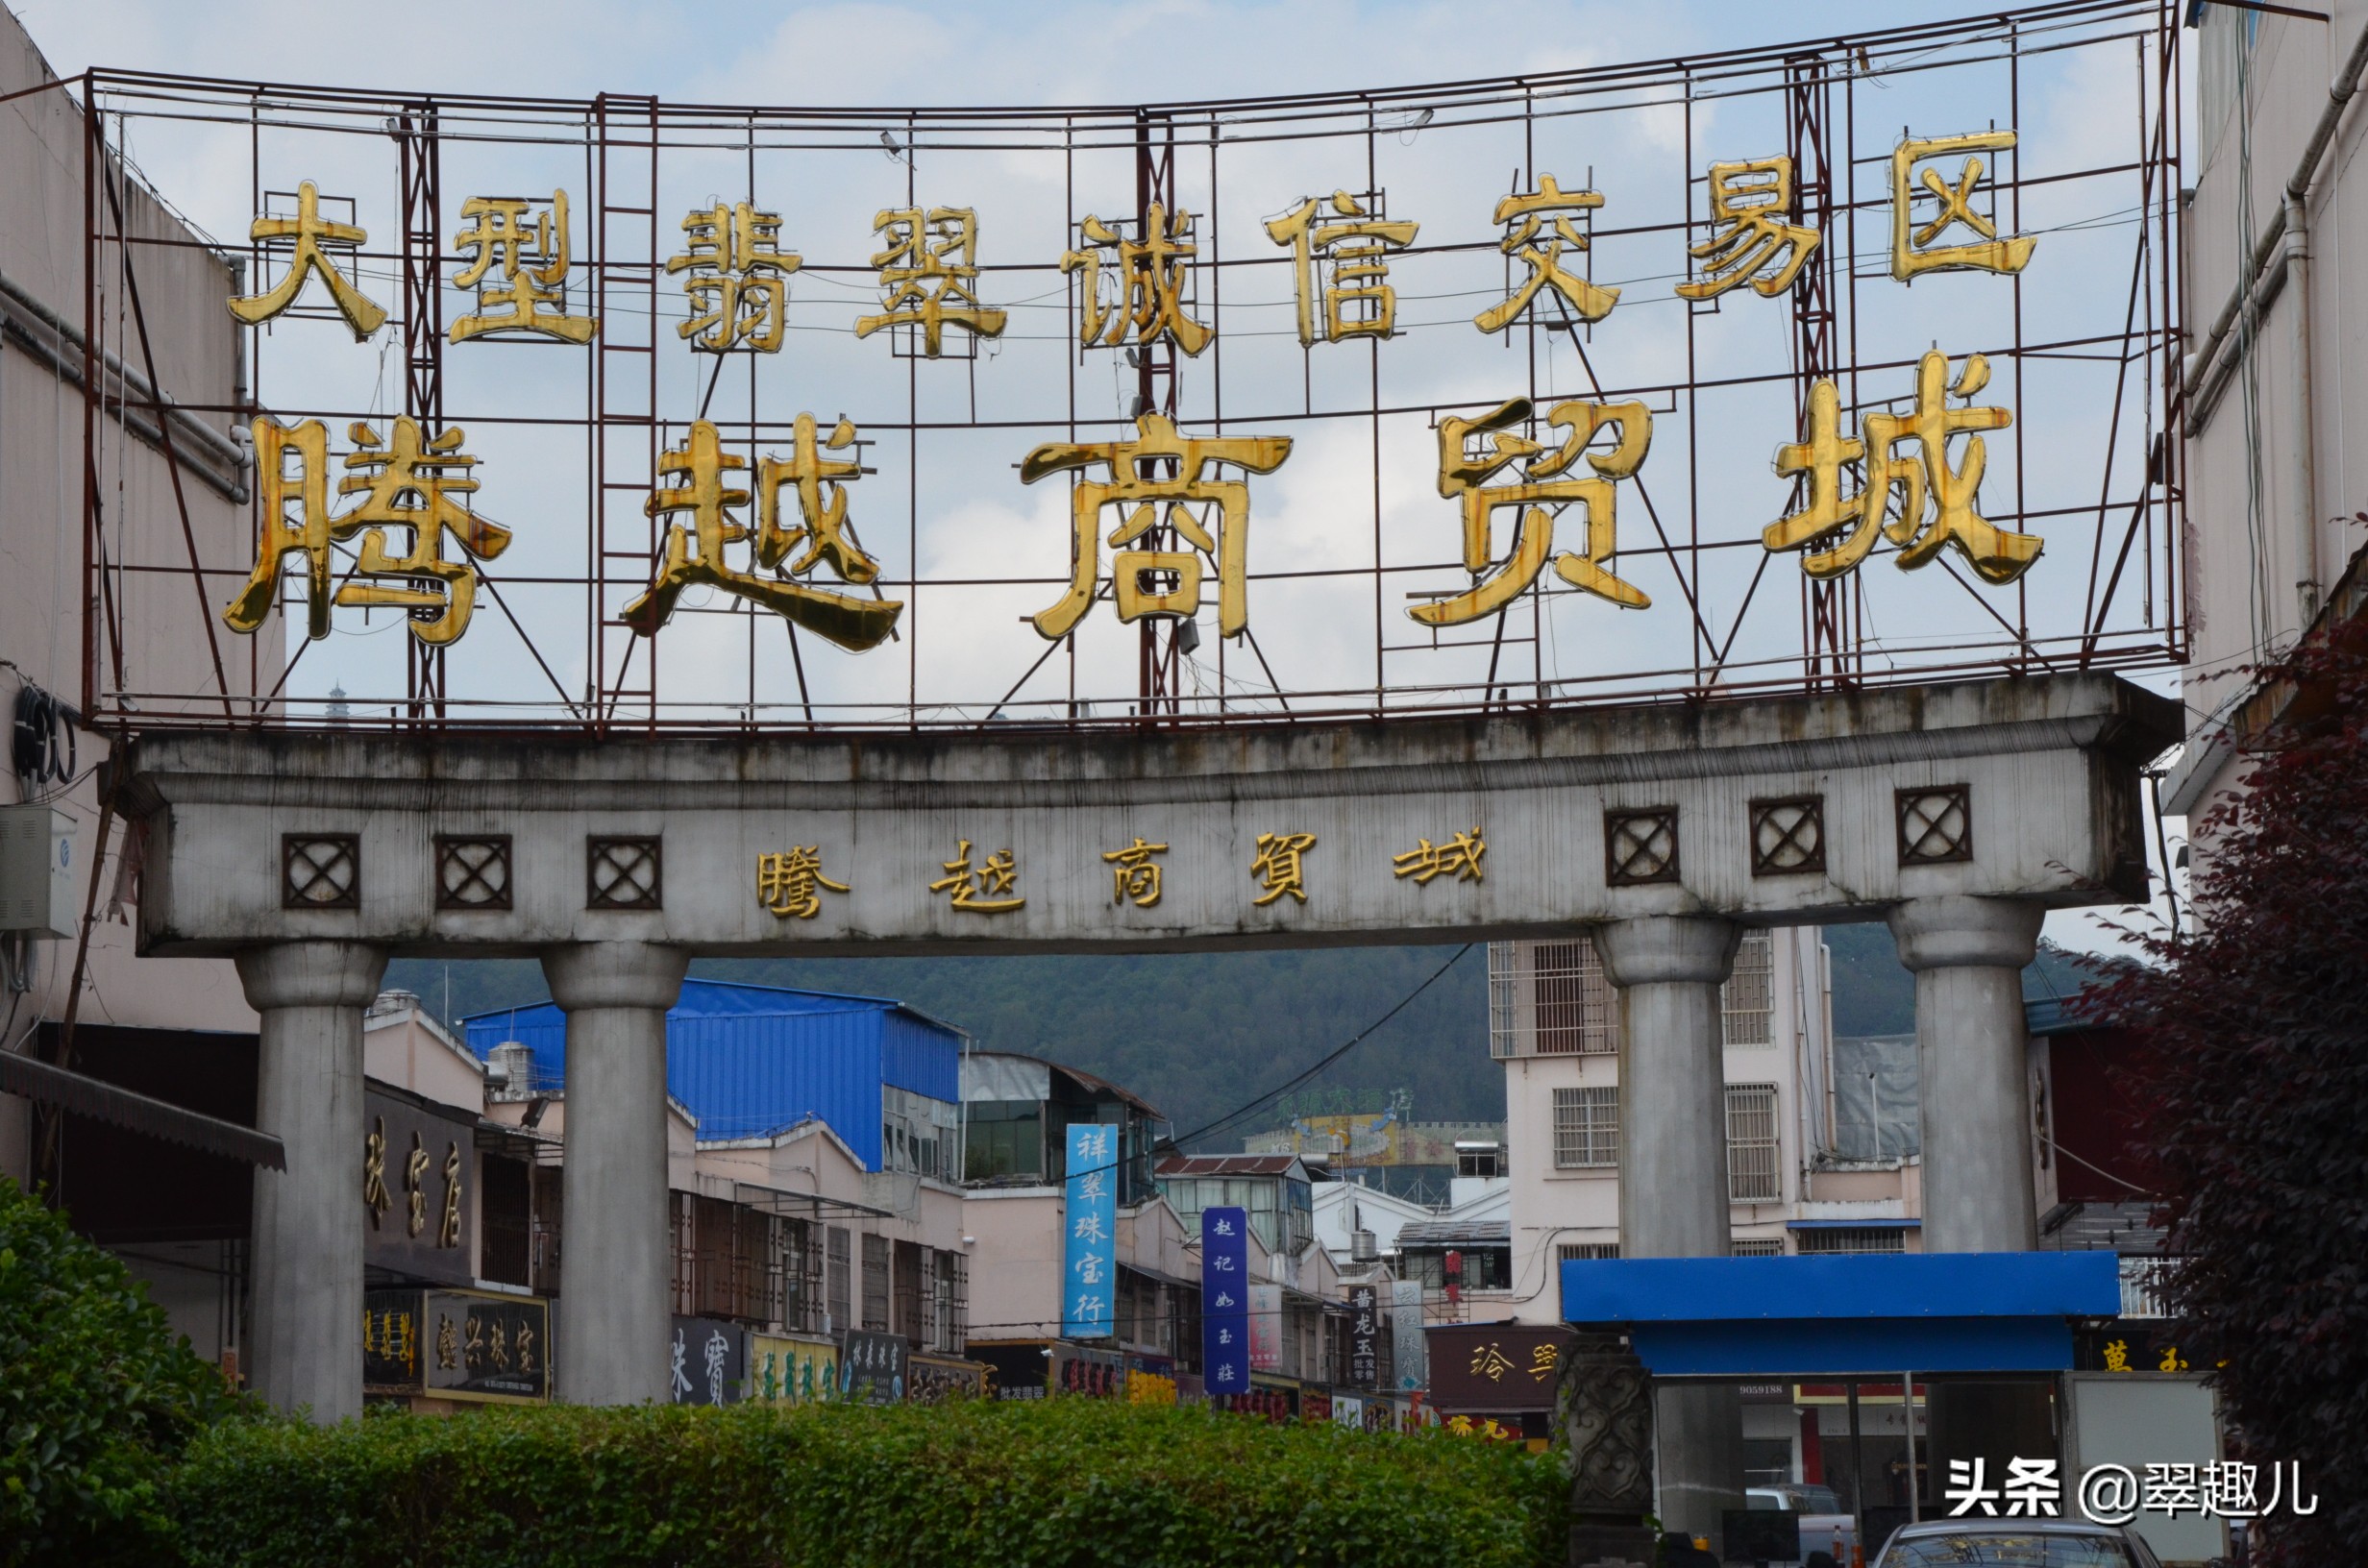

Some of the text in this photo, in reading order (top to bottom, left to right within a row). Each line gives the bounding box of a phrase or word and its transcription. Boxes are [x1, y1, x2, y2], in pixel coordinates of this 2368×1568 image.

[226, 131, 2036, 359] 大型翡翠诚信交易区
[222, 350, 2044, 653] 腾越商贸城
[1073, 1133, 1108, 1326] 祥翠珠宝行
[1352, 1288, 1375, 1358] 黄龙玉
[1353, 1359, 1375, 1369] 批发
[1739, 1384, 1783, 1394] 9059188
